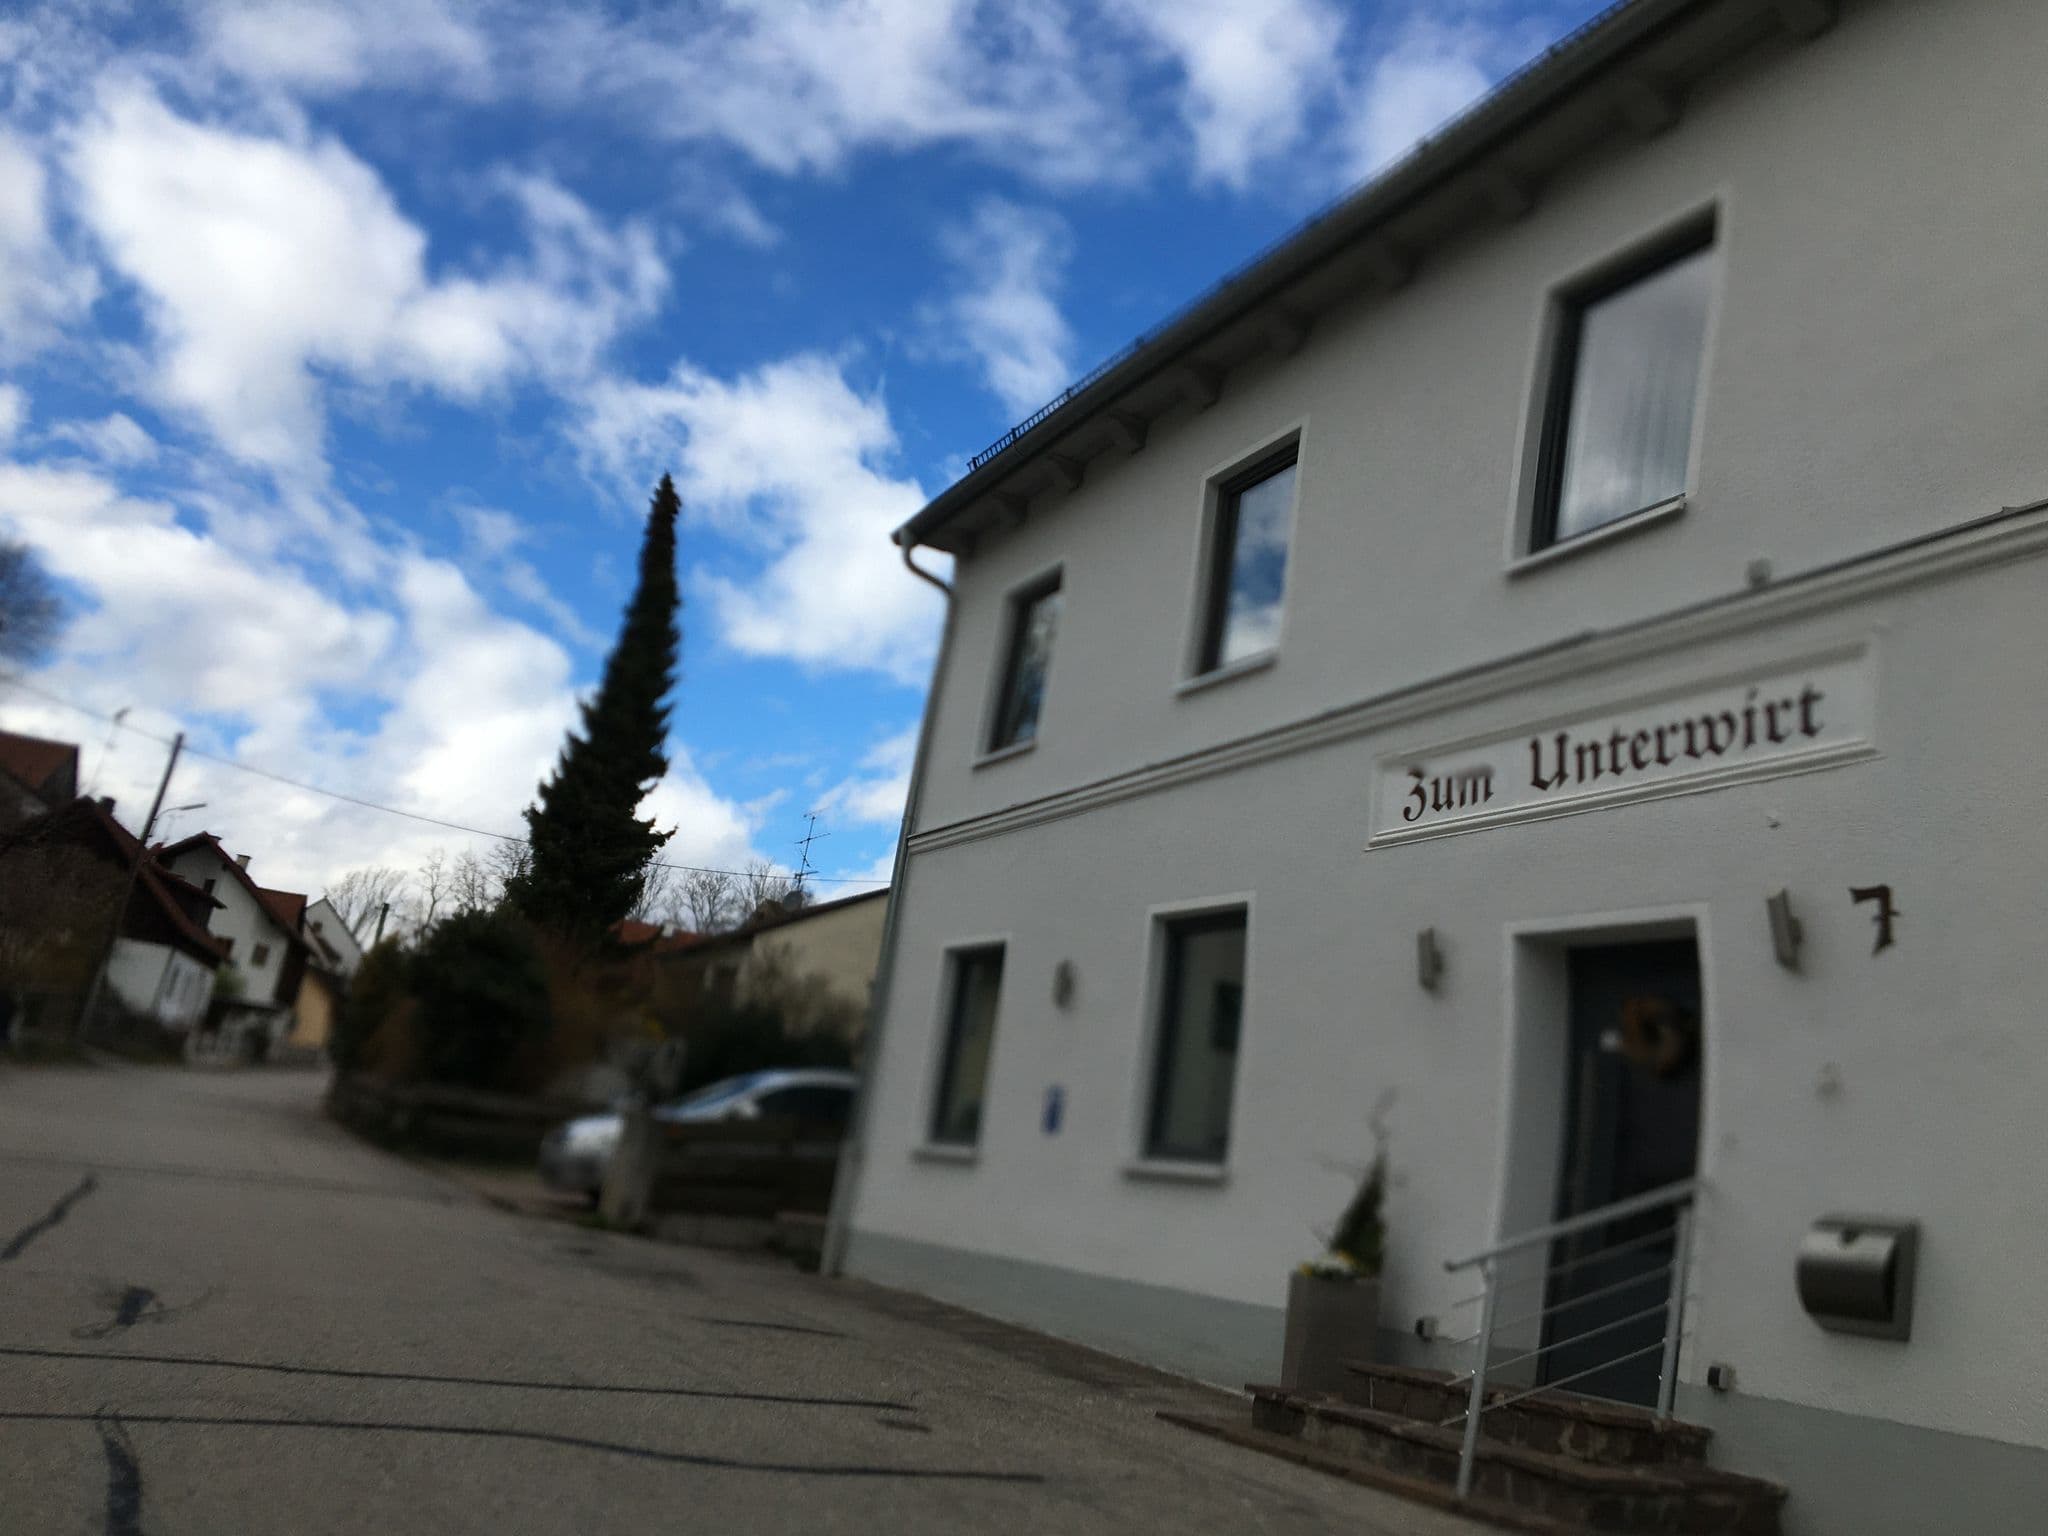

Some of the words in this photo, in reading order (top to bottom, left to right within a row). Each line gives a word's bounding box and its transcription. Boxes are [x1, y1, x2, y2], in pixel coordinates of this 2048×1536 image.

[1403, 765, 1494, 821] Zum
[1529, 685, 1824, 791] Unterwirt
[1850, 885, 1900, 955] 7
